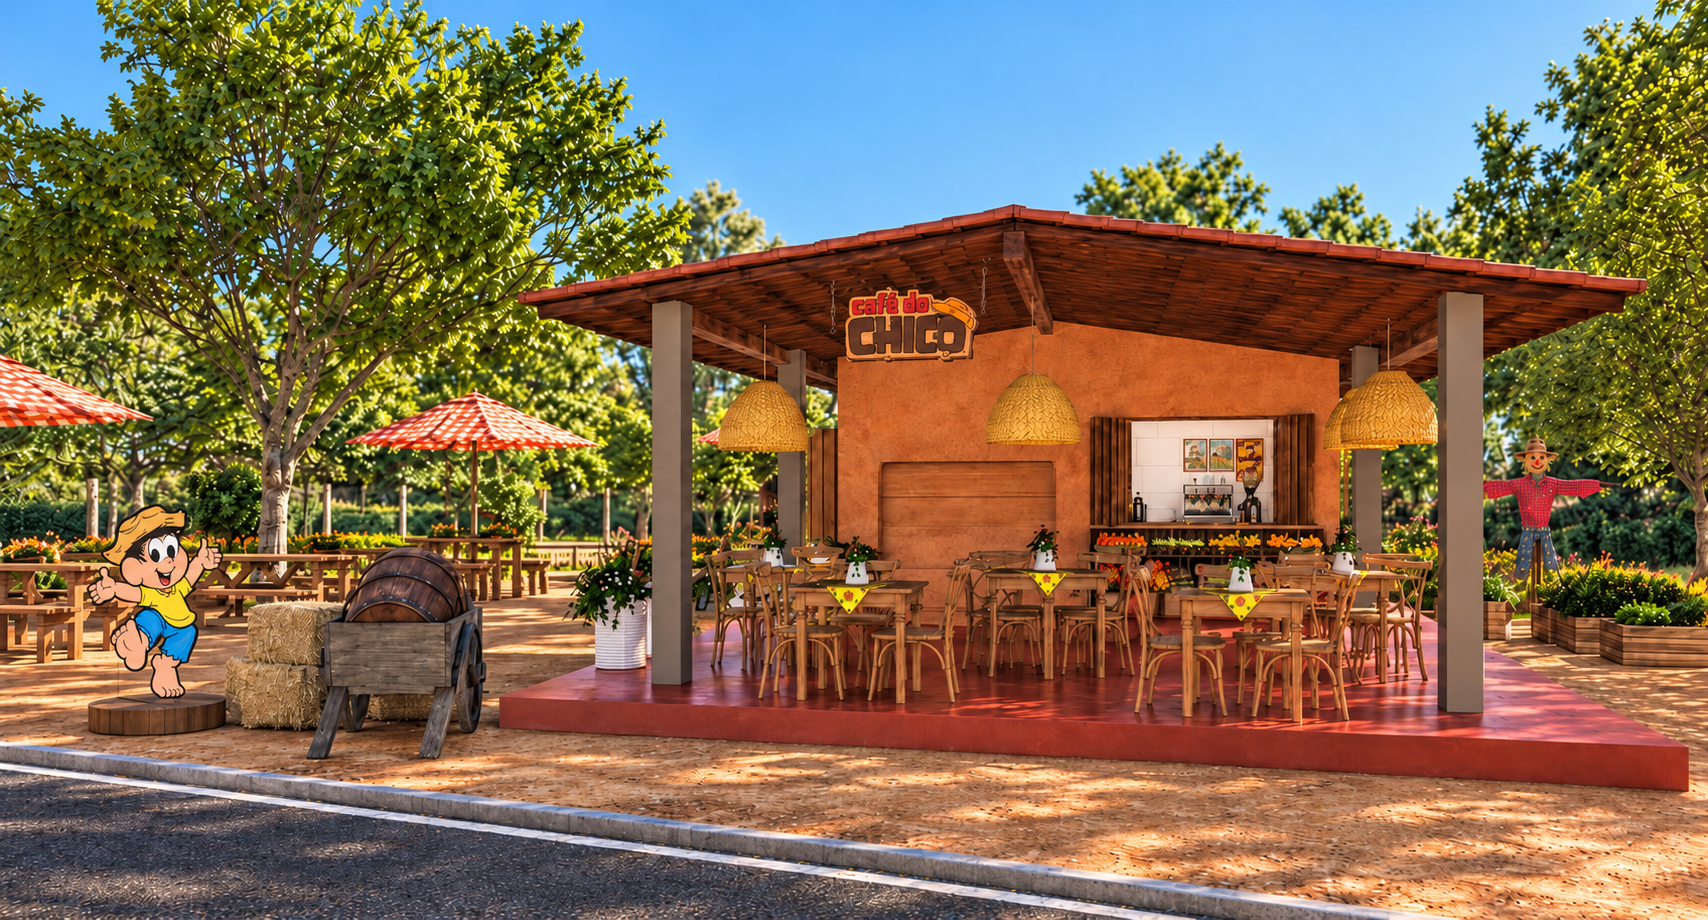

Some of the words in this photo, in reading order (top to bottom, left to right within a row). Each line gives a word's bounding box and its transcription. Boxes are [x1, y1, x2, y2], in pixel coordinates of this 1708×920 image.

[852, 292, 898, 314] café
[904, 292, 929, 313] do
[848, 315, 966, 355] CHICO
